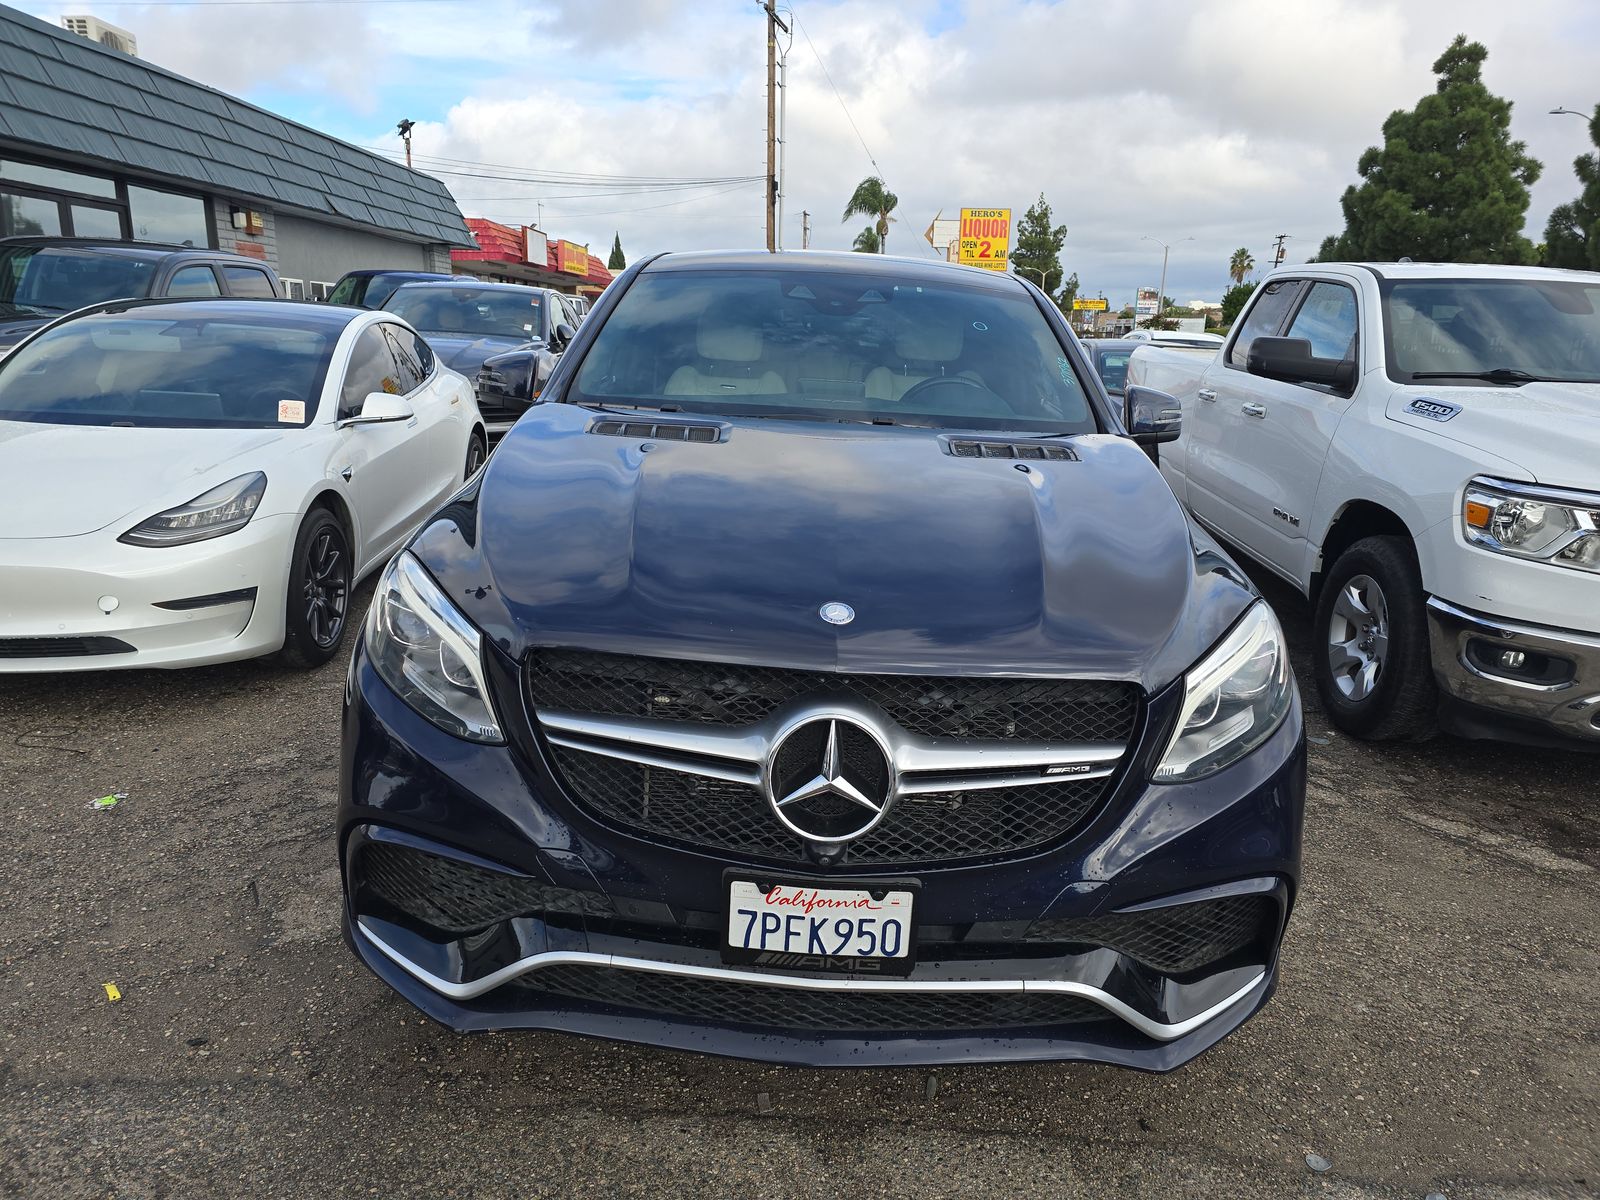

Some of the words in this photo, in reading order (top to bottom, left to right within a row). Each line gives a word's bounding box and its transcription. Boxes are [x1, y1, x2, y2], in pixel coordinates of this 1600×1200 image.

[970, 210, 1003, 218] HERO'S
[962, 218, 1008, 240] LIQUOR
[961, 240, 978, 249] OPEN
[978, 240, 992, 258] 2
[994, 250, 1006, 258] AM
[1414, 401, 1451, 415] 1500
[765, 885, 883, 914] California
[737, 909, 902, 957] 7PFK950
